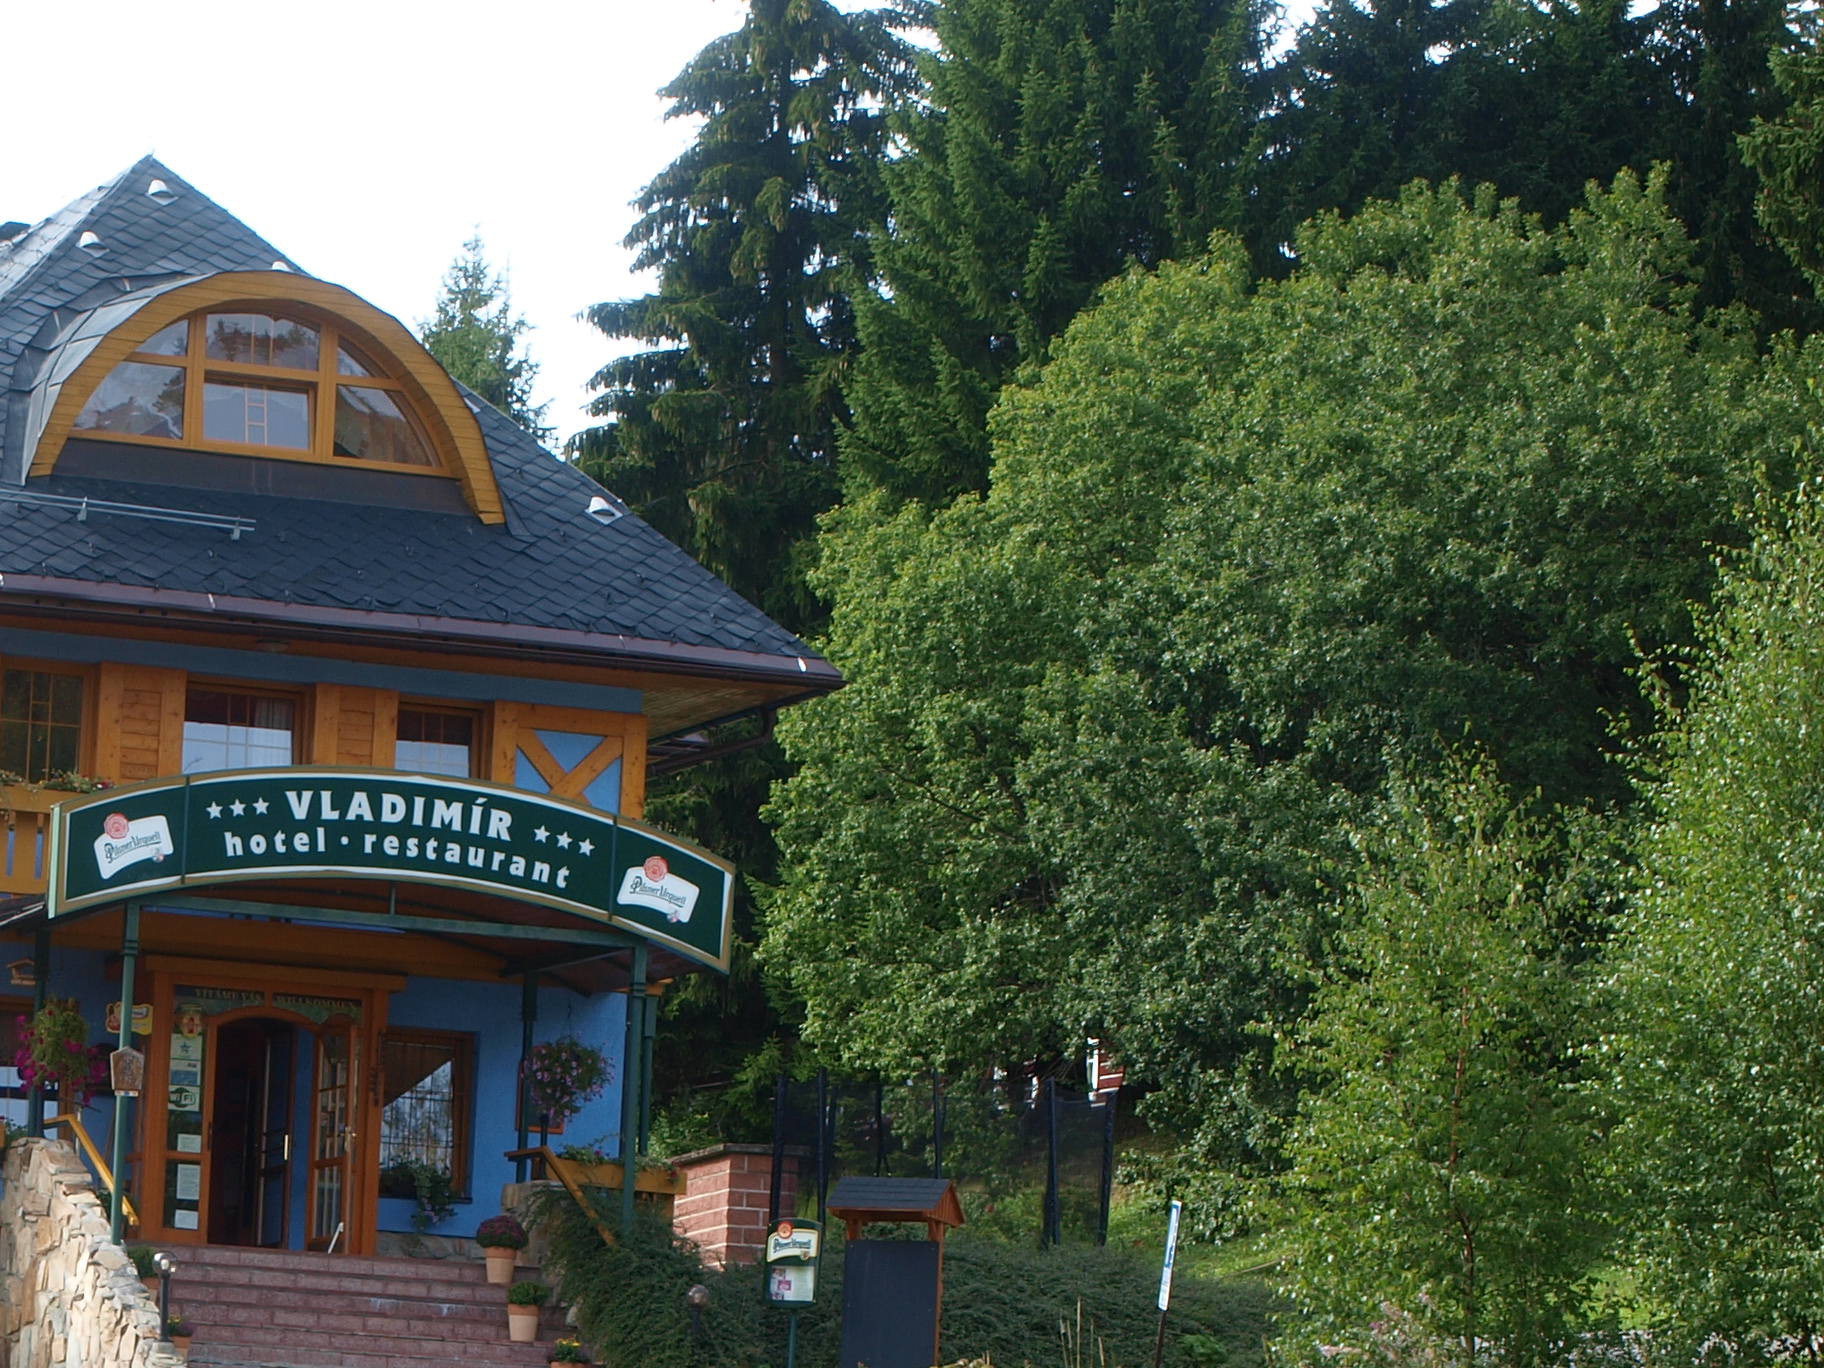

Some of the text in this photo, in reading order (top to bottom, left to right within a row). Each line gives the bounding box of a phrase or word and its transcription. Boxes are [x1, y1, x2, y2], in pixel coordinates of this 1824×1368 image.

[285, 790, 512, 842] VLADIMÍR
[224, 827, 570, 889] hotel restaurant
